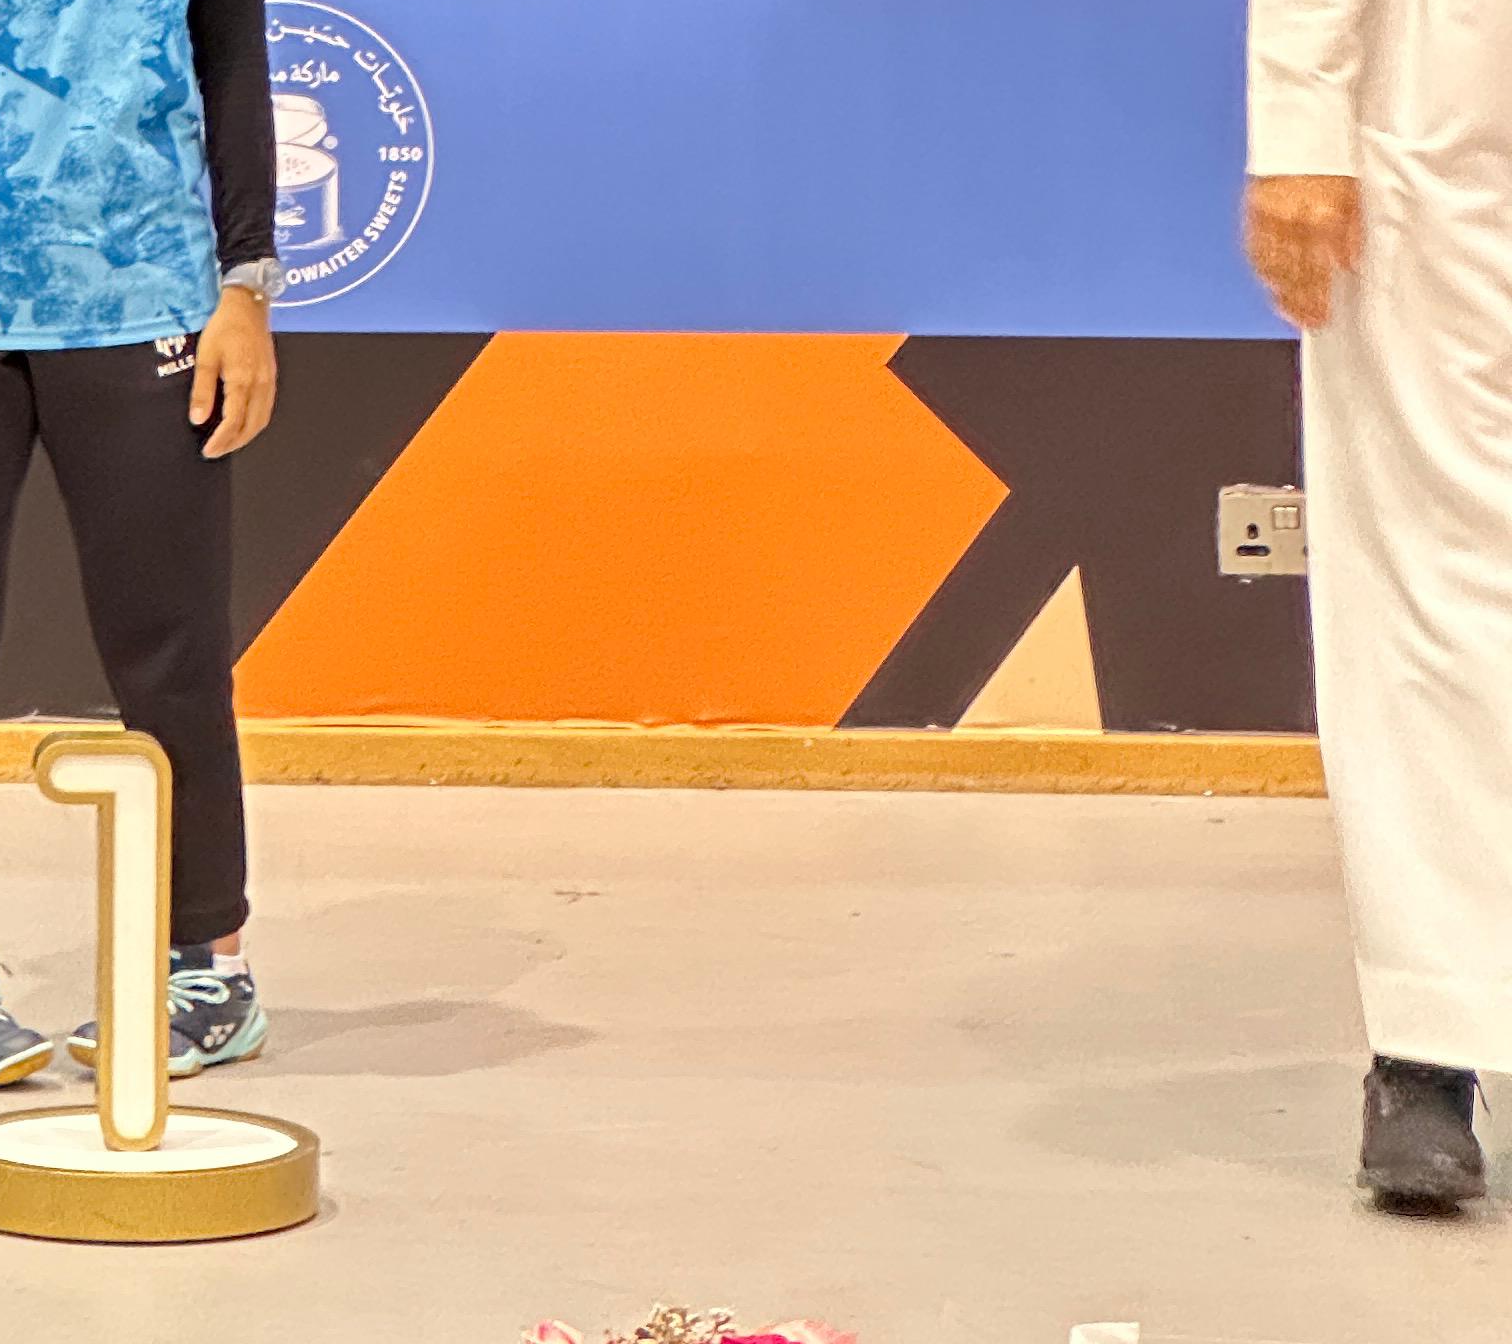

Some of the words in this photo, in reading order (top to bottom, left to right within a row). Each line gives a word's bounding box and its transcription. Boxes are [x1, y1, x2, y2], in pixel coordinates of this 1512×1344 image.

[378, 146, 423, 162] 1850
[286, 238, 369, 285] OWAITER
[363, 170, 408, 242] SWEETS
